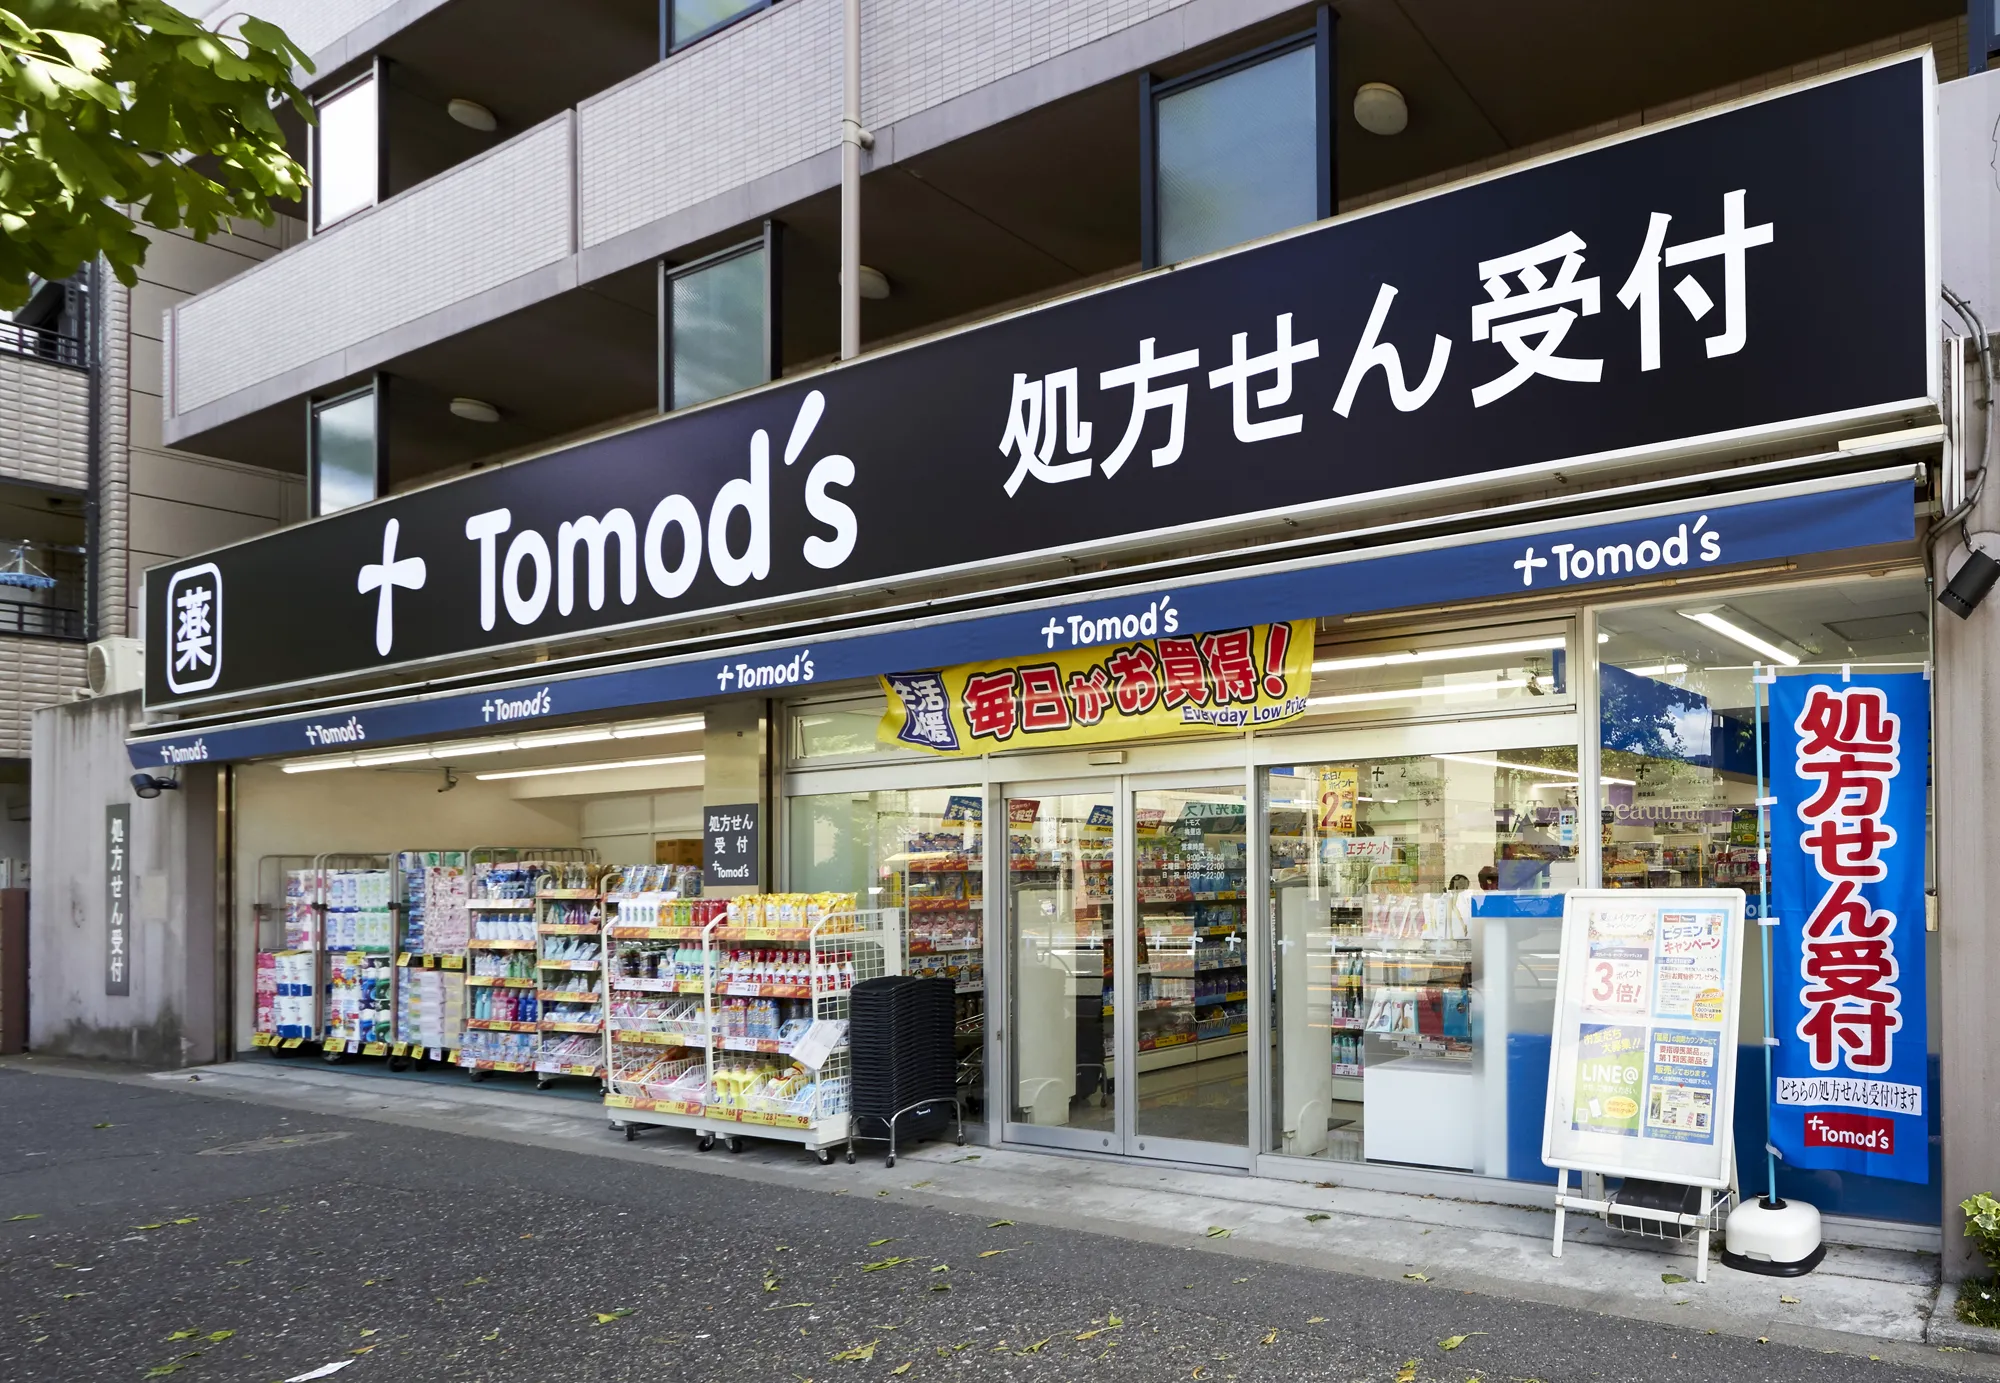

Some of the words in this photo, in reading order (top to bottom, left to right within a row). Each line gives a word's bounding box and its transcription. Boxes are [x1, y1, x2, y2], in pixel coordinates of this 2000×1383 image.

[998, 188, 1774, 499] 処方せん受付
[465, 390, 858, 632] Tomod's
[1550, 514, 1721, 581] Tomod's
[175, 586, 213, 673] 薬
[1071, 595, 1179, 644] Tomod's
[747, 649, 815, 688] Tomod's
[495, 686, 552, 721] Tomod's
[1182, 704, 1248, 727] Everyday
[1253, 704, 1282, 722] Low
[318, 715, 366, 743] Tomod's
[910, 711, 952, 743] 援
[169, 738, 209, 763] Tomod's
[1400, 767, 1407, 778] 2
[708, 812, 754, 833] 処方せん
[1185, 818, 1201, 827] トモズ
[1321, 791, 1340, 828] 2
[1340, 814, 1353, 829] 倍
[1181, 842, 1205, 851] 営業時間
[1346, 841, 1390, 856] エチケット
[717, 863, 750, 879] Tomod's
[1800, 690, 1898, 1068] 処方せん受付
[109, 817, 125, 983] 処方せん受付
[1163, 892, 1175, 900] 950
[766, 928, 776, 936] 98
[1662, 924, 1704, 941] ビタミン
[1664, 937, 1721, 955] キャンペーン
[747, 984, 758, 992] 212
[1592, 961, 1614, 1002] 3
[1616, 968, 1642, 980] ポイント
[1582, 1063, 1639, 1085] LINE@
[1780, 1079, 1918, 1112] どちらの処方せんも受付けます
[797, 1116, 809, 1125] 98
[1818, 1125, 1890, 1150] Tomod's
